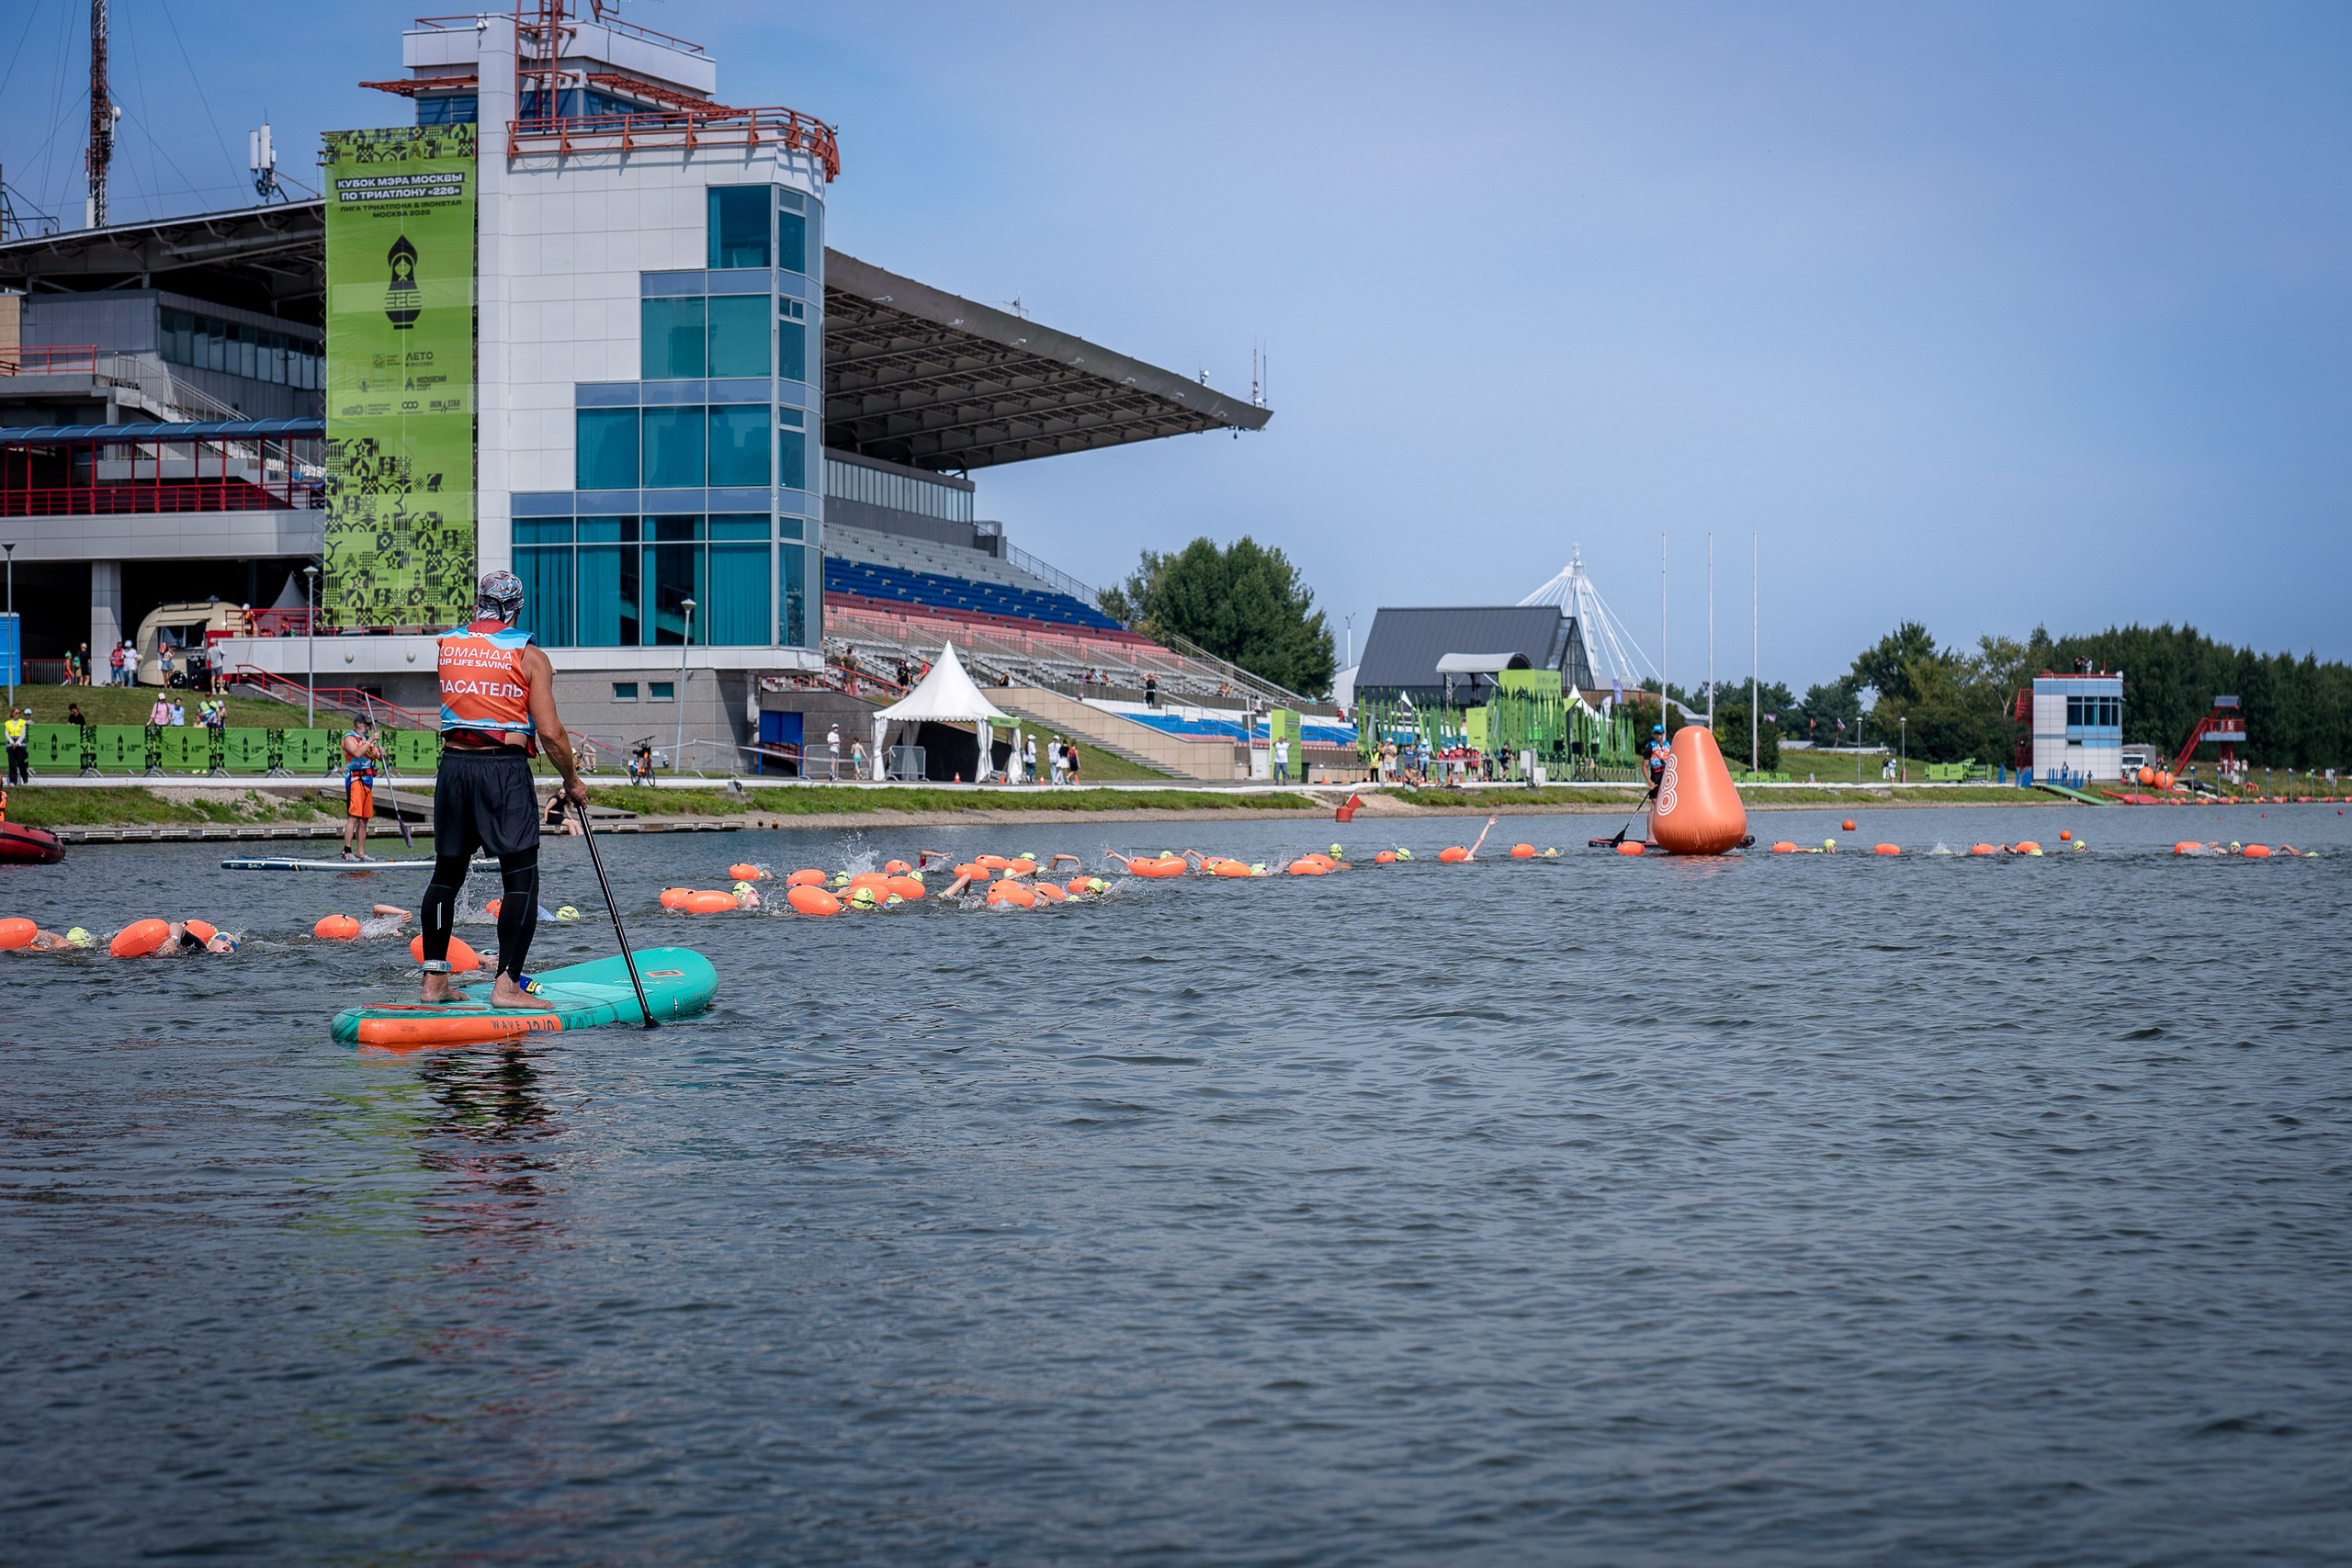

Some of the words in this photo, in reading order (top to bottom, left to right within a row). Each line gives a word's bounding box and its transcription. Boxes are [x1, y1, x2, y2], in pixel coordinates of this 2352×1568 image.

[337, 178, 376, 188] КУБОК
[378, 176, 410, 186] МЭРА
[411, 174, 462, 185] МОСКВЫ
[341, 192, 357, 200] ПО
[359, 188, 426, 199] ТРИАТЛОНУ
[427, 186, 460, 196] «226»
[363, 203, 412, 211] ТРИАТЛОНА
[439, 658, 452, 666] UP
[453, 659, 474, 667] LIFE
[475, 660, 512, 671] SAVING
[491, 1020, 521, 1031] WAVE
